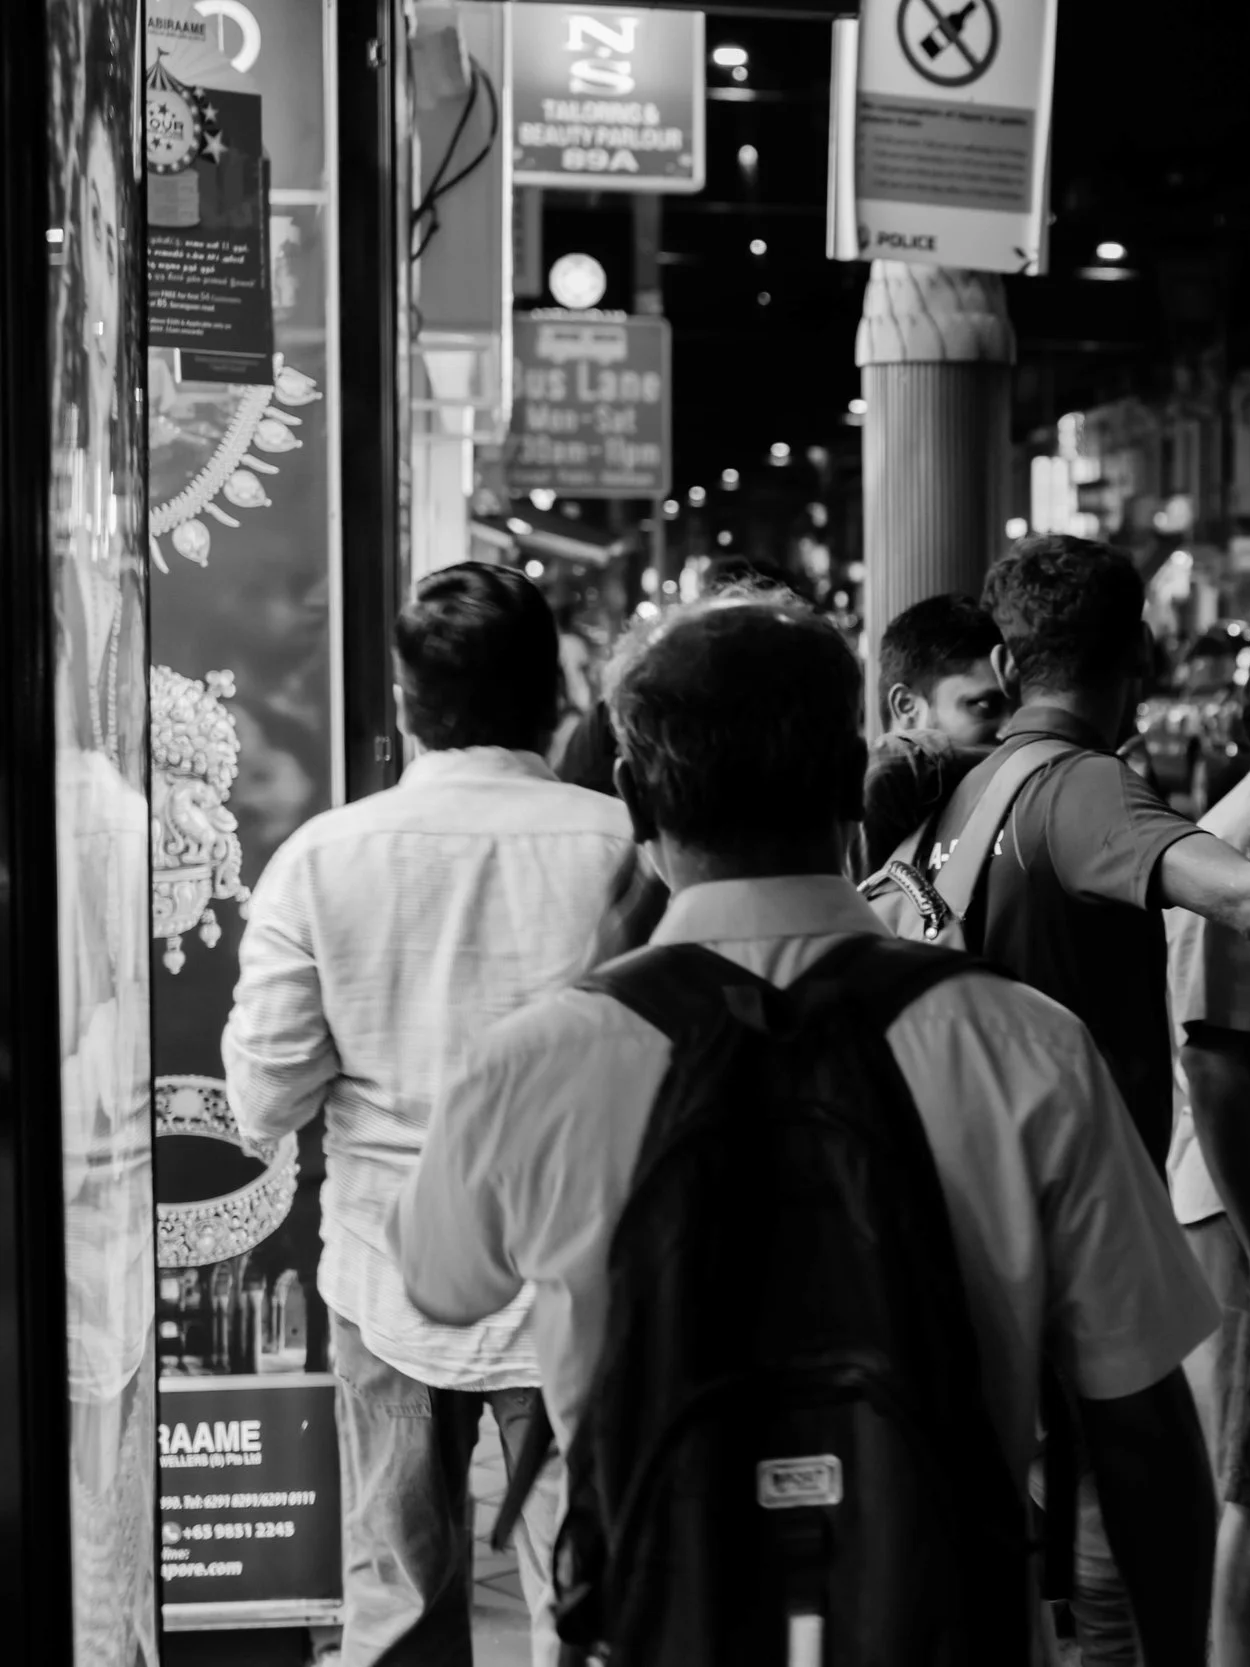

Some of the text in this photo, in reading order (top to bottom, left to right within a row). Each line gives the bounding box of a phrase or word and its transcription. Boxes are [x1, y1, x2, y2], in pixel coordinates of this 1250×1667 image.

[148, 16, 206, 34] ABIRAAME
[876, 231, 938, 252] POLICE
[576, 359, 661, 404] Lane
